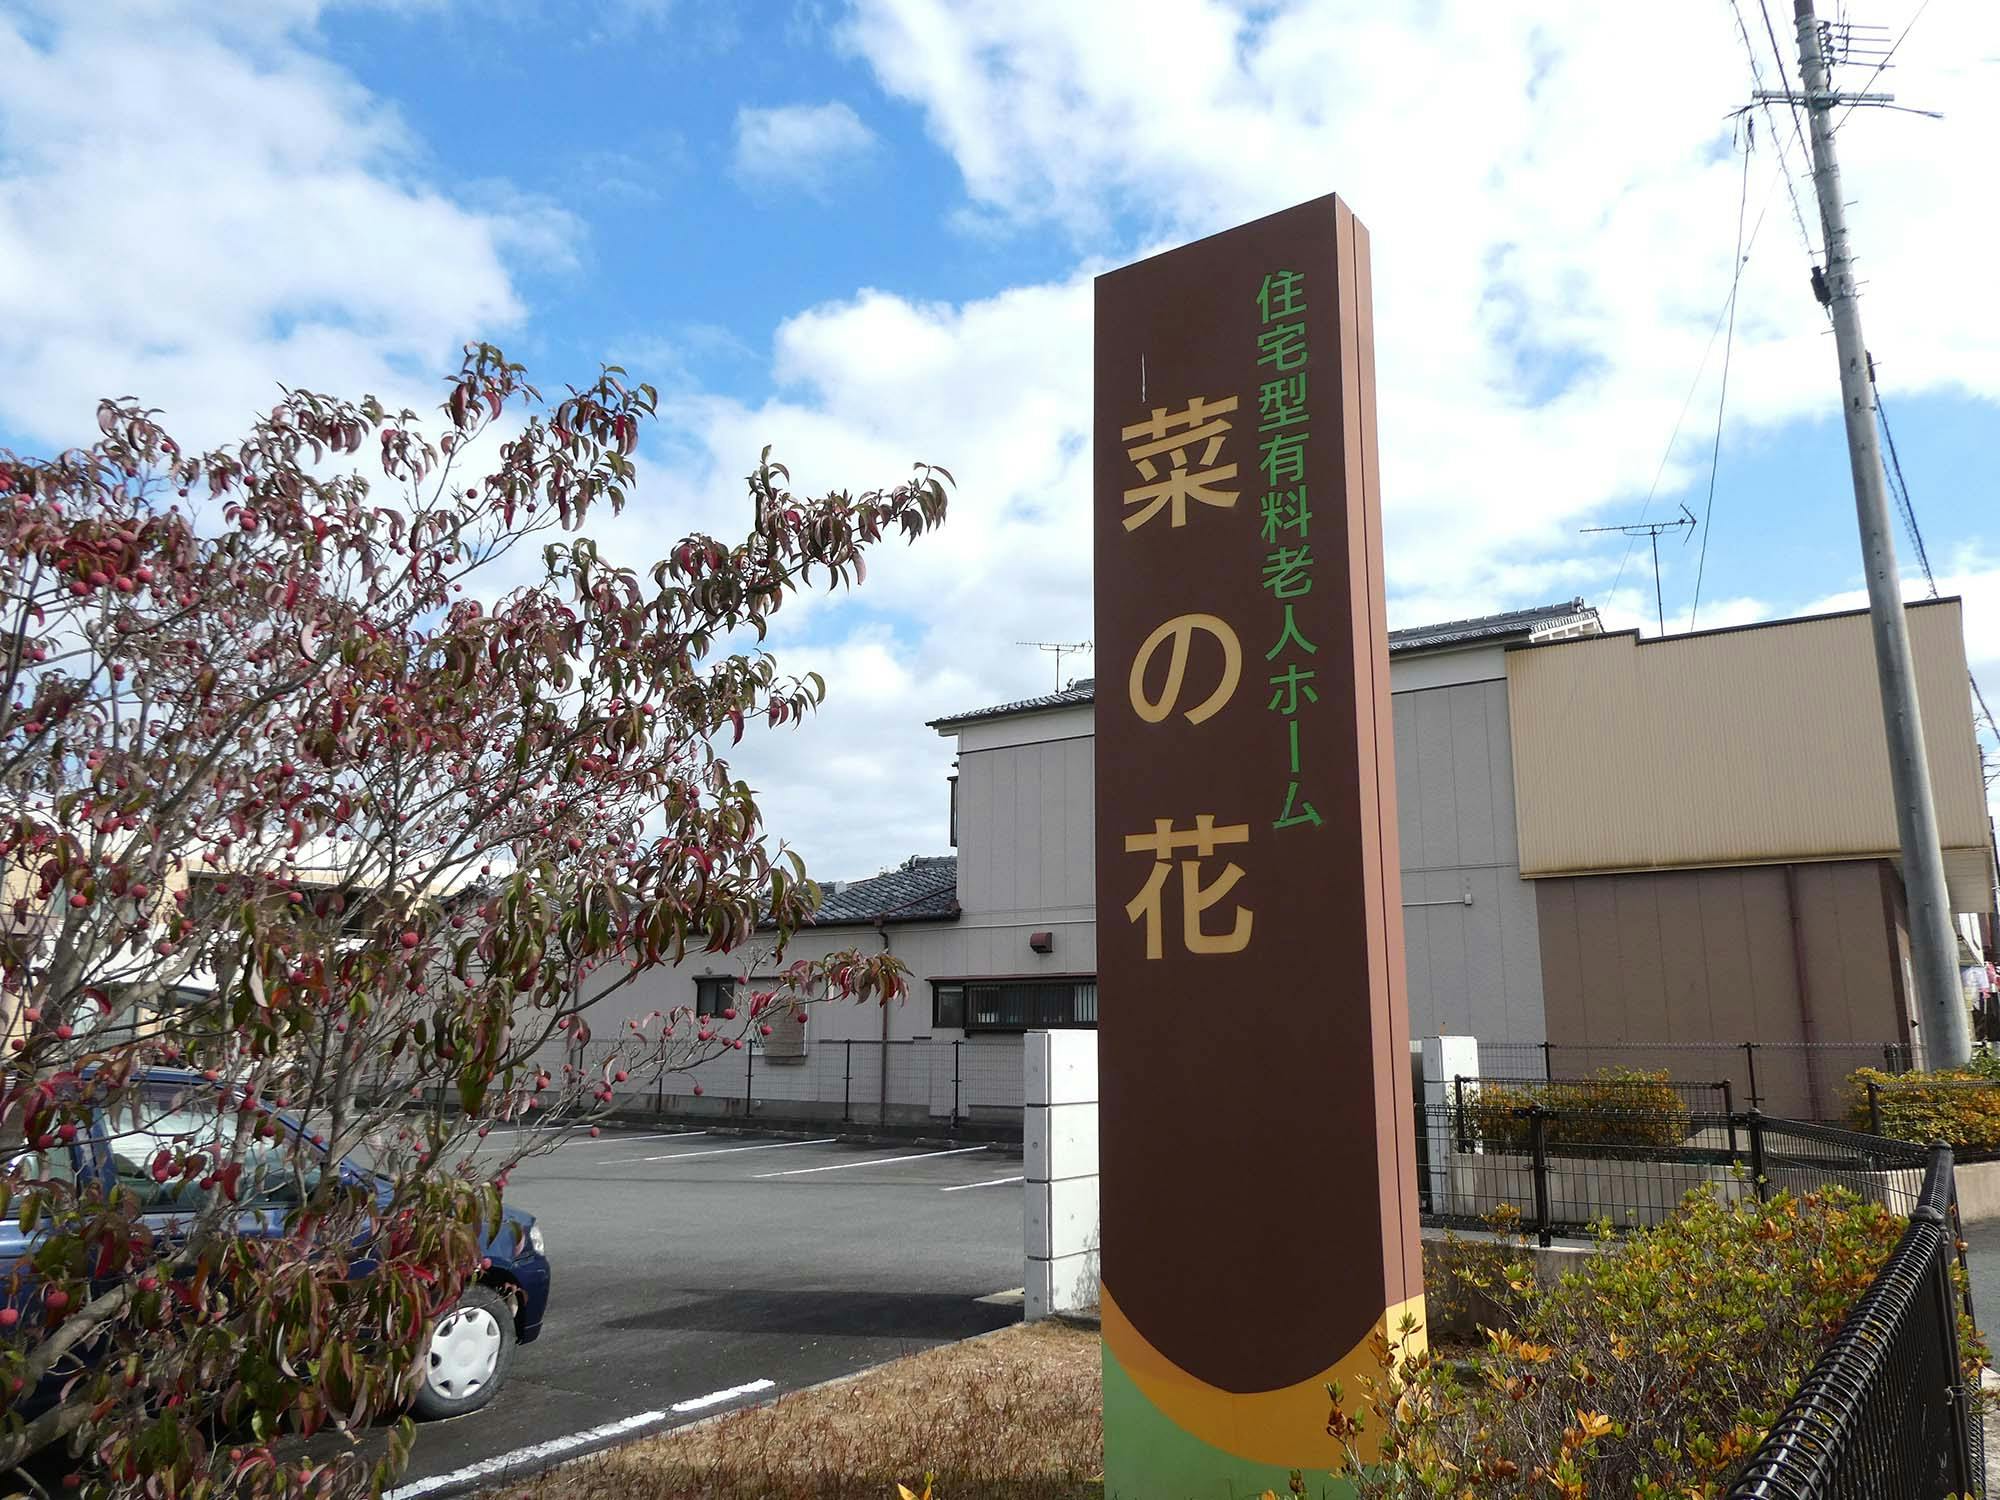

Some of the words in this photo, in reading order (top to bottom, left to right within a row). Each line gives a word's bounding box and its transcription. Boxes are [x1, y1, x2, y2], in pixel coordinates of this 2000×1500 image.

[1121, 395, 1254, 961] 菜の花
[1256, 269, 1324, 830] 住宅型有料老人ホーム
